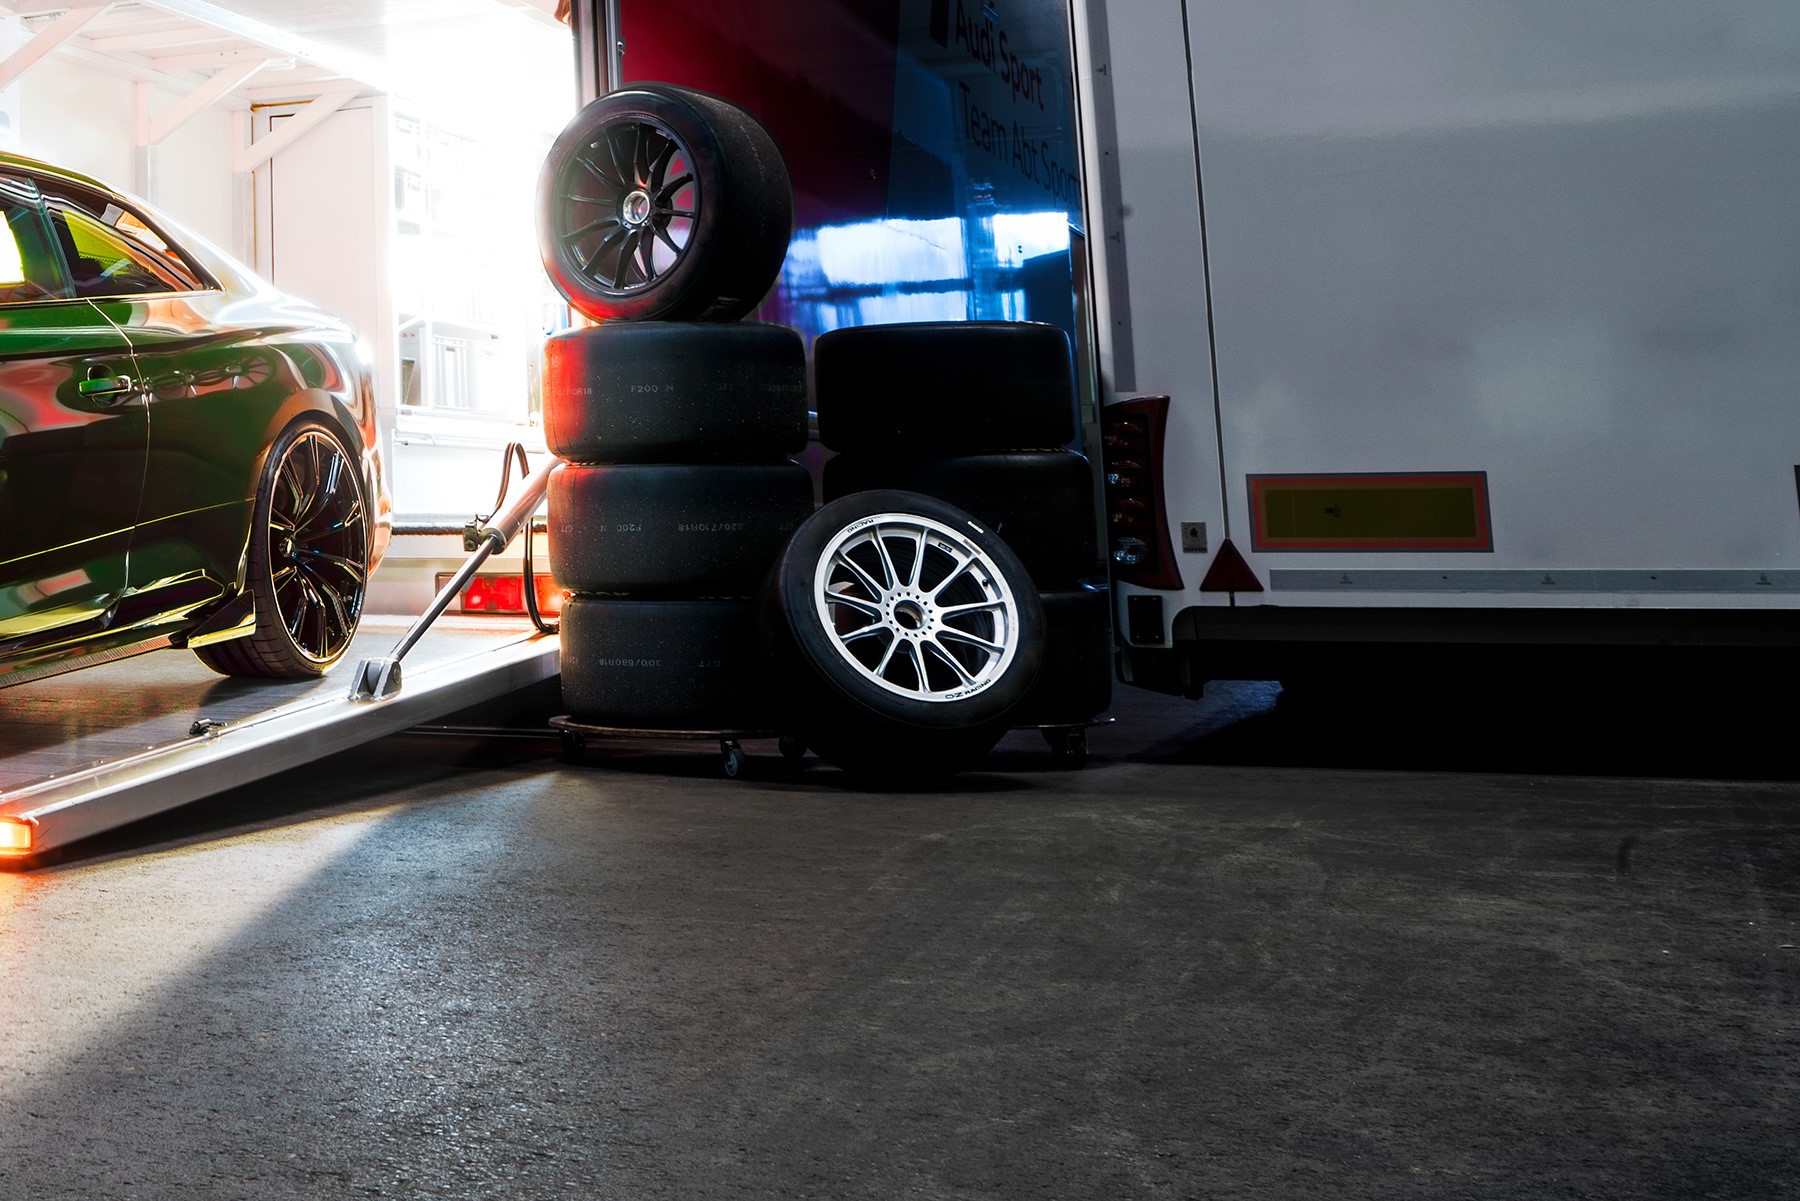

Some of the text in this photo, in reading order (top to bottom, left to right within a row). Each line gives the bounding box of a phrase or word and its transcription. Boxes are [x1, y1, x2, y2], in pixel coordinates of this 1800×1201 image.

[999, 30, 1044, 111] Sport
[959, 80, 1008, 165] Team
[1012, 120, 1040, 185] Abt
